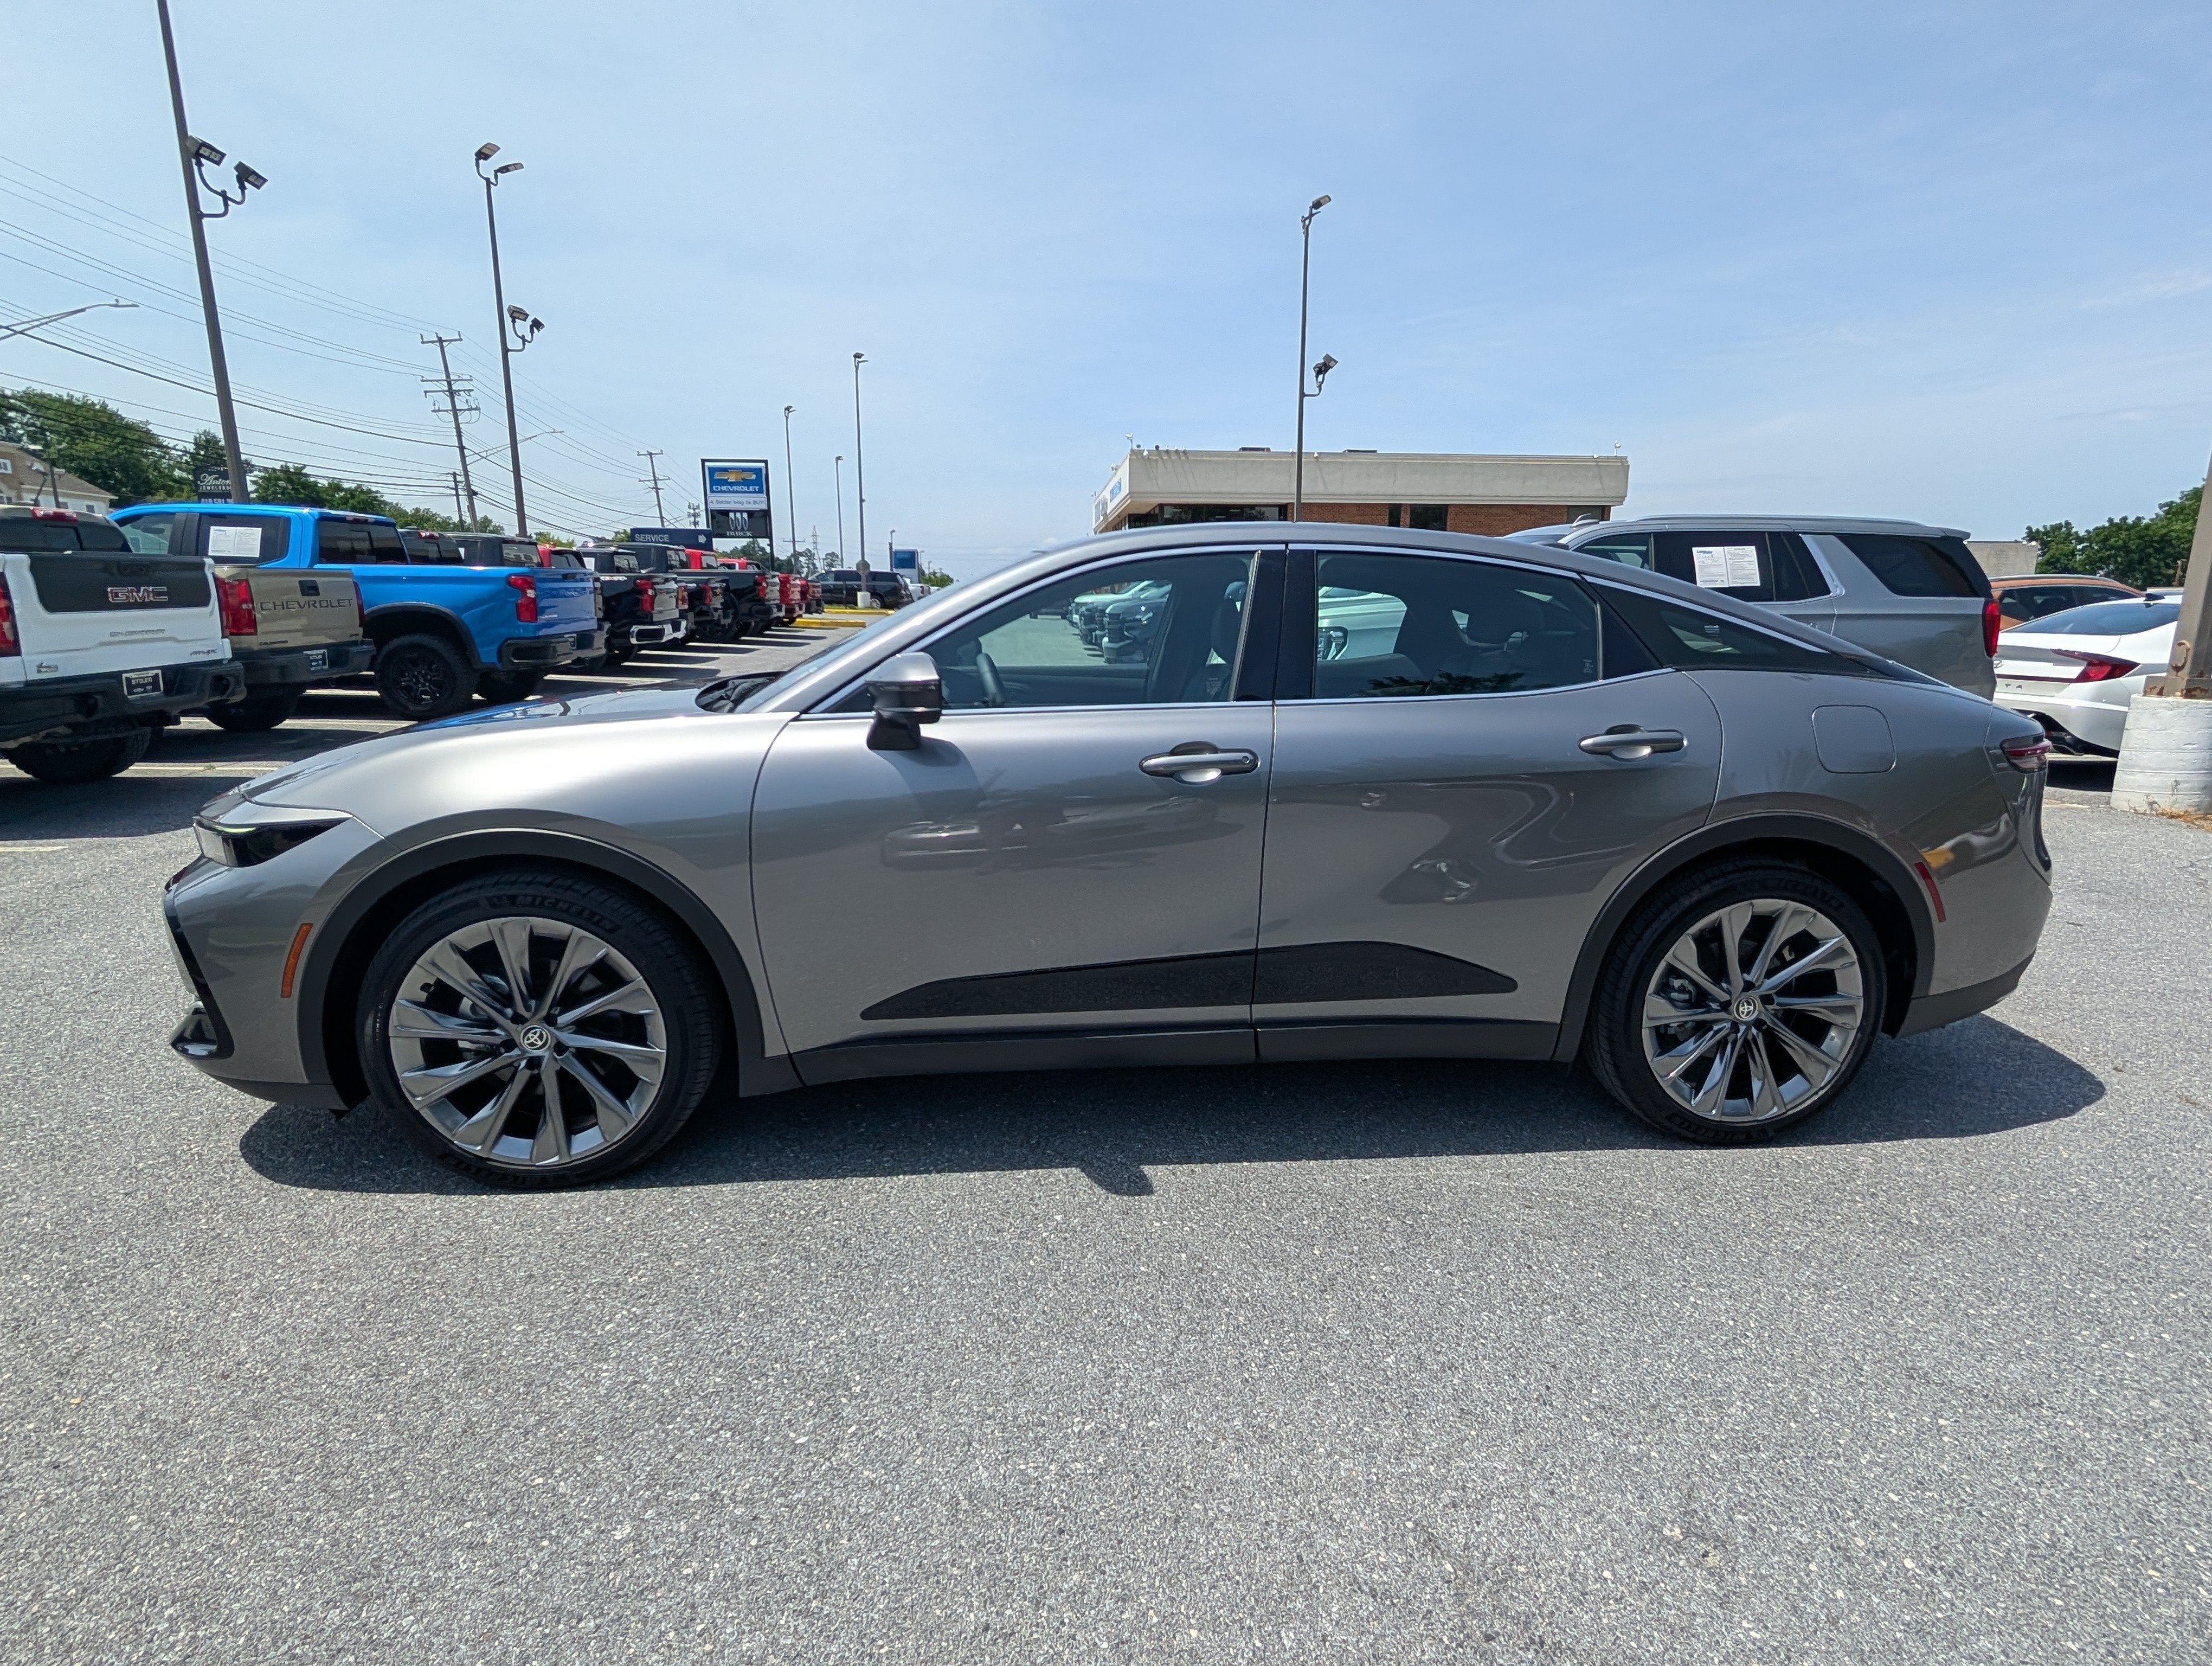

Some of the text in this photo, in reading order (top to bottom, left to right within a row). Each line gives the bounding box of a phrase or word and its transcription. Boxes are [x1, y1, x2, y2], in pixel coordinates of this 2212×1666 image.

[634, 534, 670, 542] SERVICE
[107, 586, 168, 603] GMC
[260, 598, 353, 611] CHEVROLET
[516, 895, 615, 931] MICHELIN
